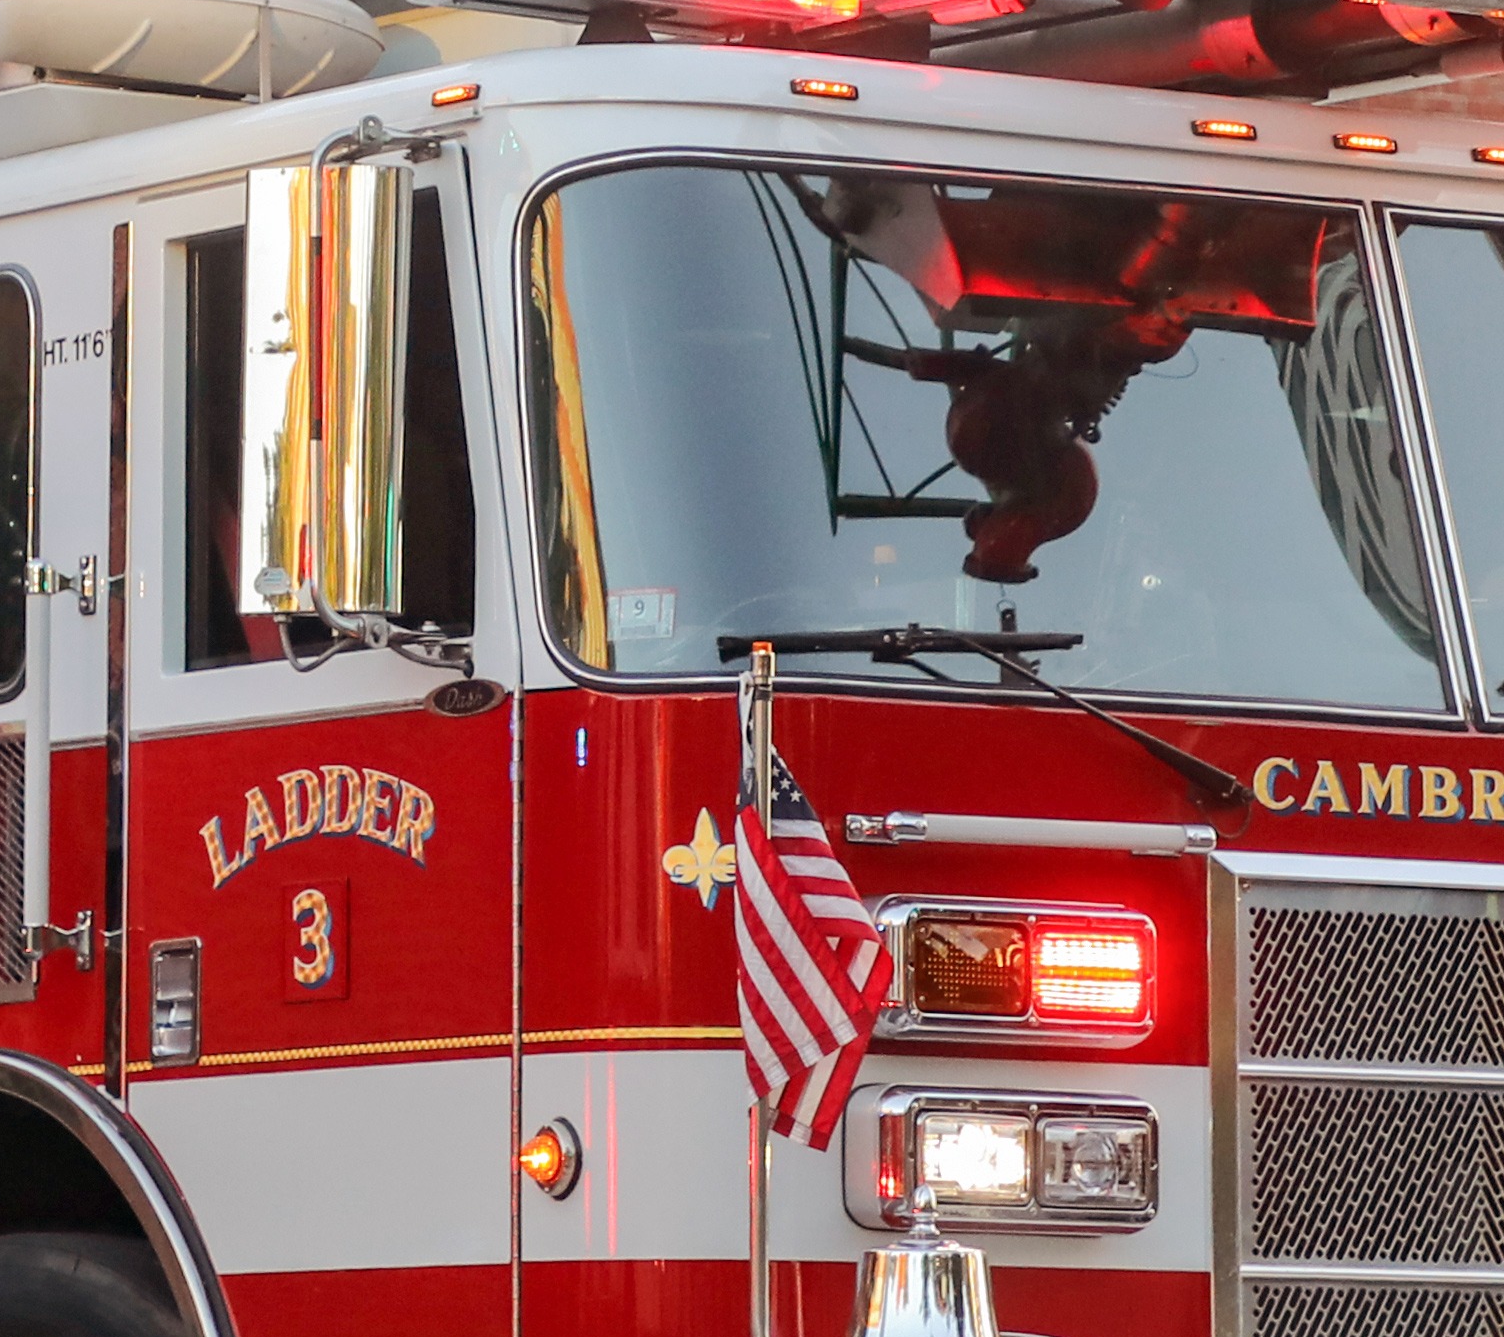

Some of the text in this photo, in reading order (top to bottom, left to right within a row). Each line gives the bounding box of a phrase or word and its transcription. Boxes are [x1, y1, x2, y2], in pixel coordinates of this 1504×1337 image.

[43, 336, 68, 367] HT.
[634, 599, 645, 617] 9
[197, 763, 436, 891] LADDER
[291, 888, 336, 990] 3
